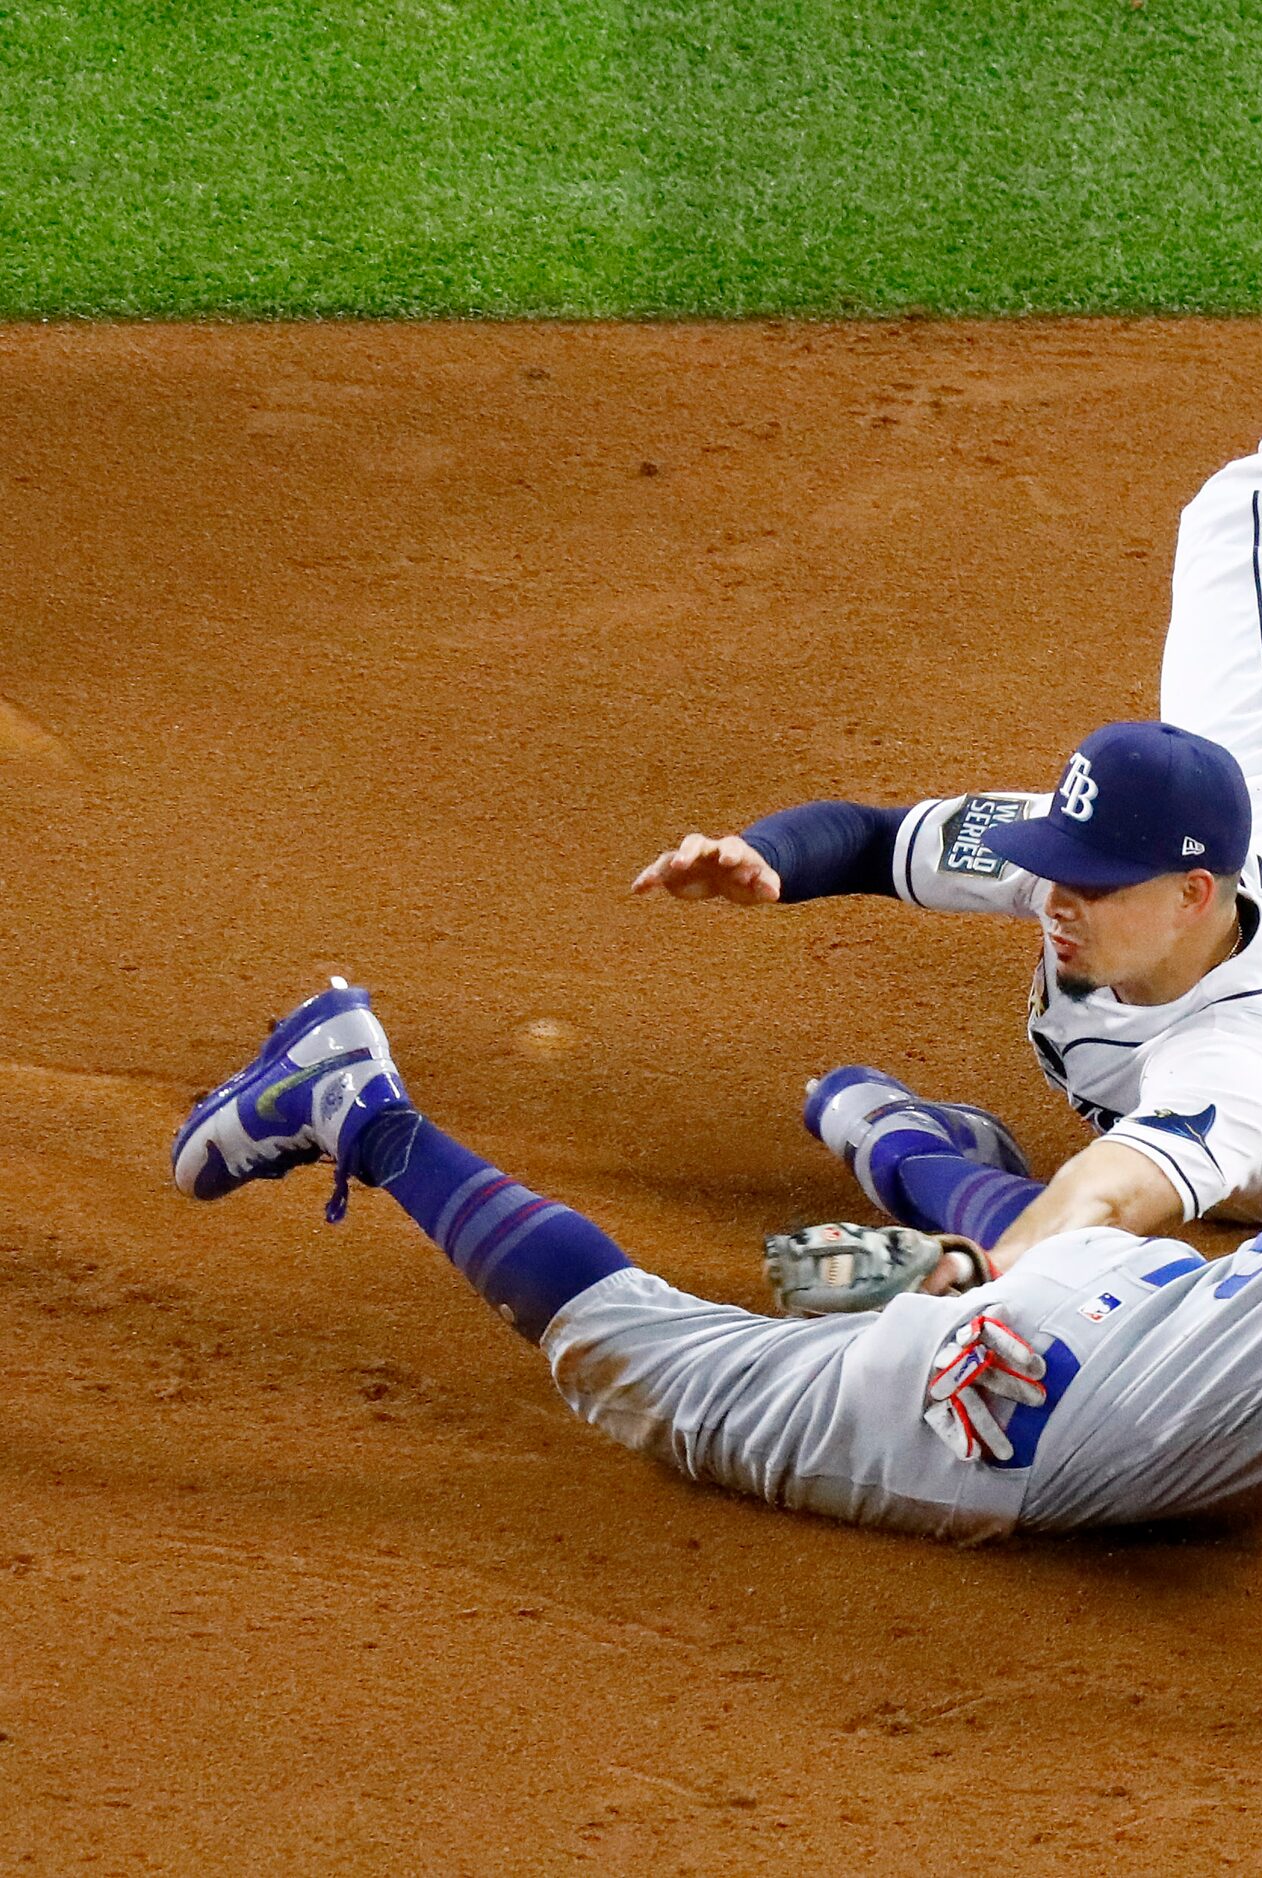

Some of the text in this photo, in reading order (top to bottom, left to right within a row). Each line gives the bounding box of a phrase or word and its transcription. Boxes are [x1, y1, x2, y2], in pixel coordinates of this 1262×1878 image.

[1059, 752, 1099, 822] TB
[947, 799, 996, 870] SERIES
[973, 803, 1019, 873] WLD
